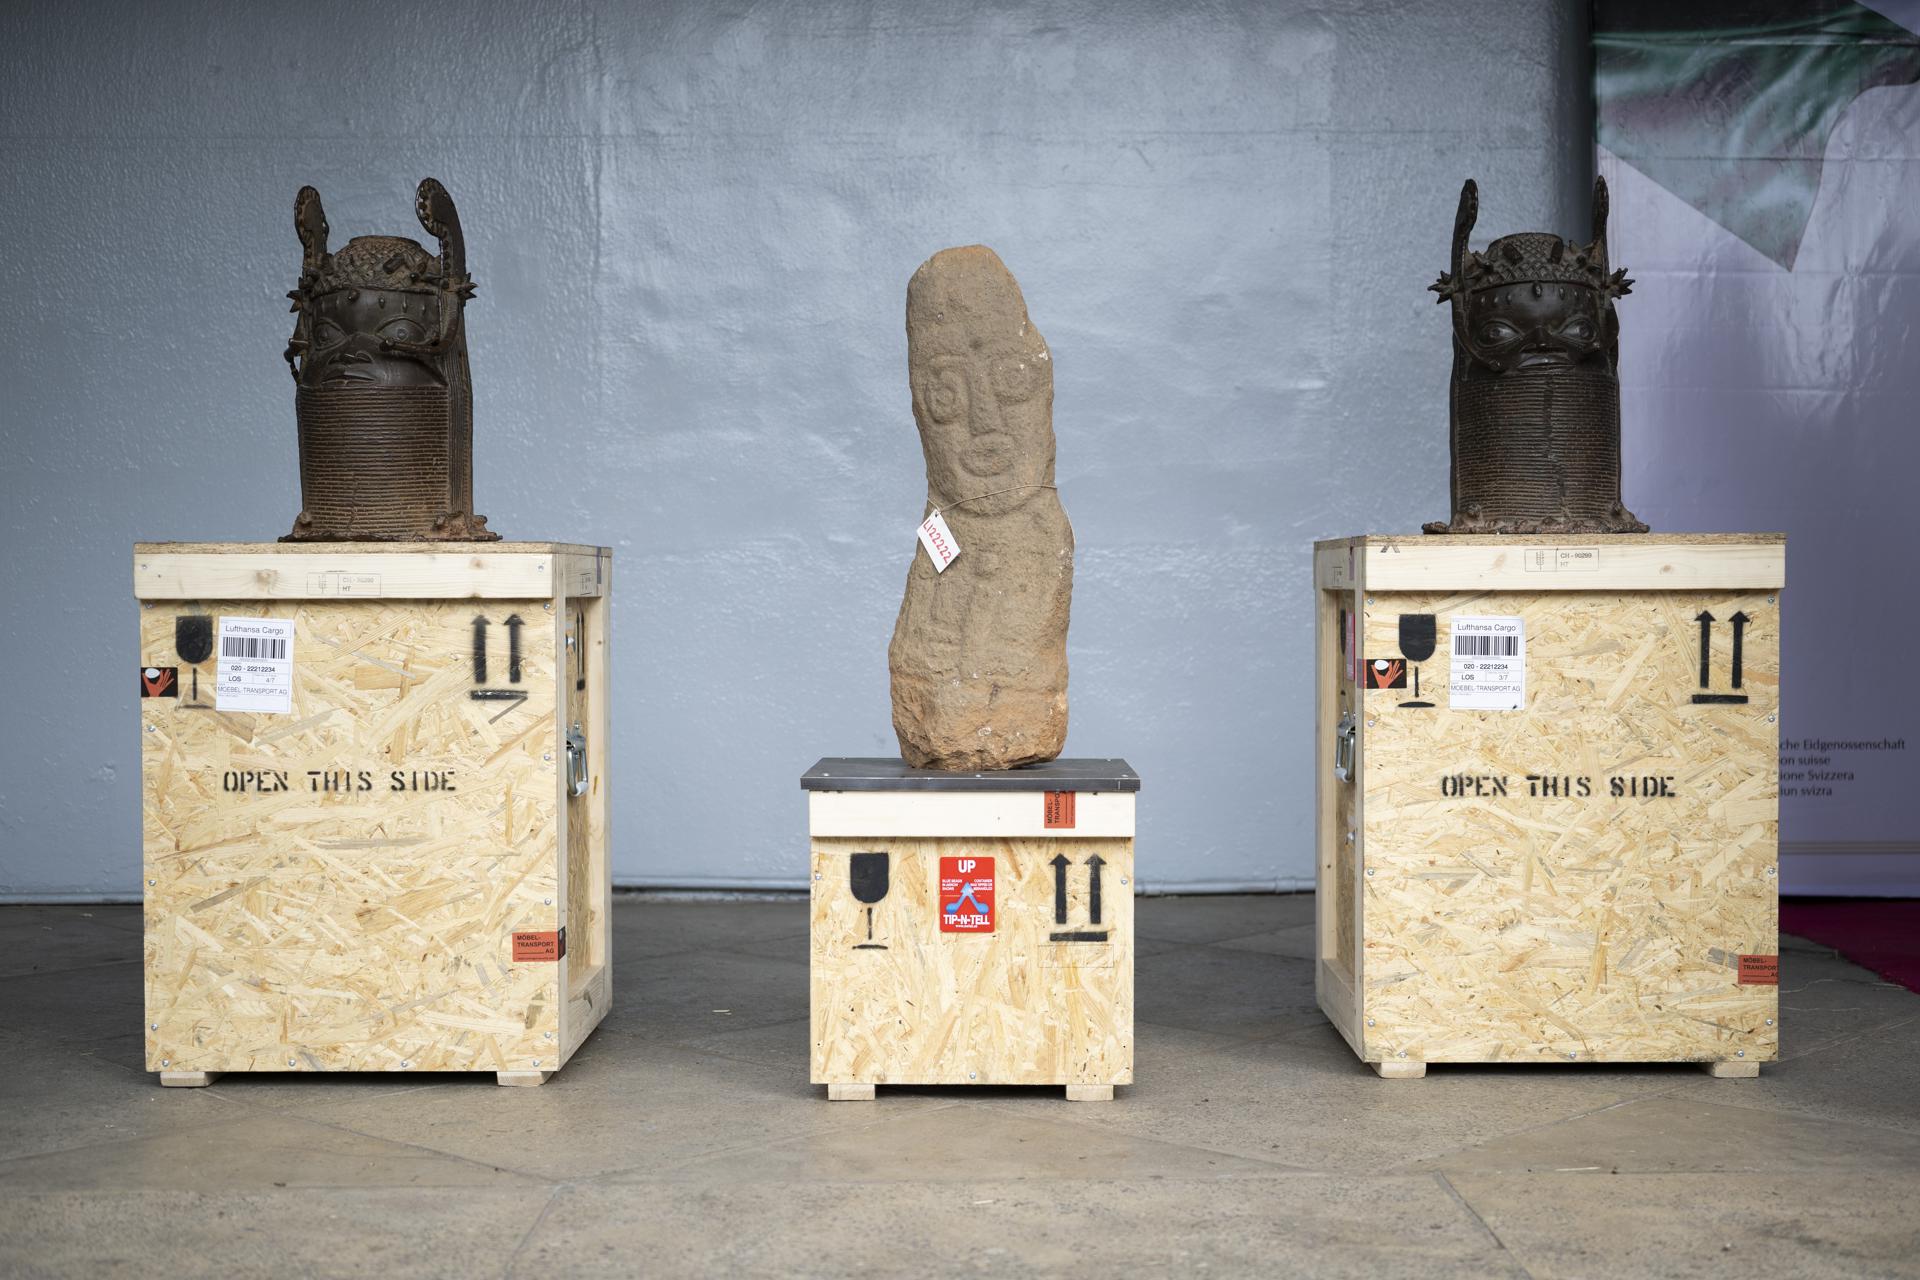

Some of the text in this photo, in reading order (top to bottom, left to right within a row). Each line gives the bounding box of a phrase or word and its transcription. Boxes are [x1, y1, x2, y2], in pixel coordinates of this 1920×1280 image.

[225, 625, 284, 635] Lufthansa Cargo
[1457, 623, 1517, 633] Lufthansa Cargo
[1780, 737, 1905, 753] che Eidgenossenschaft
[1780, 755, 1831, 766] on suisse
[223, 770, 456, 792] OPEN THIS SIDE
[1780, 769, 1855, 781] ione Svizzera
[1441, 775, 1676, 797] OPEN THIS SIDE
[1800, 785, 1833, 797] svizra
[957, 859, 976, 873] UP
[943, 914, 991, 925] TIP-N-TELL
